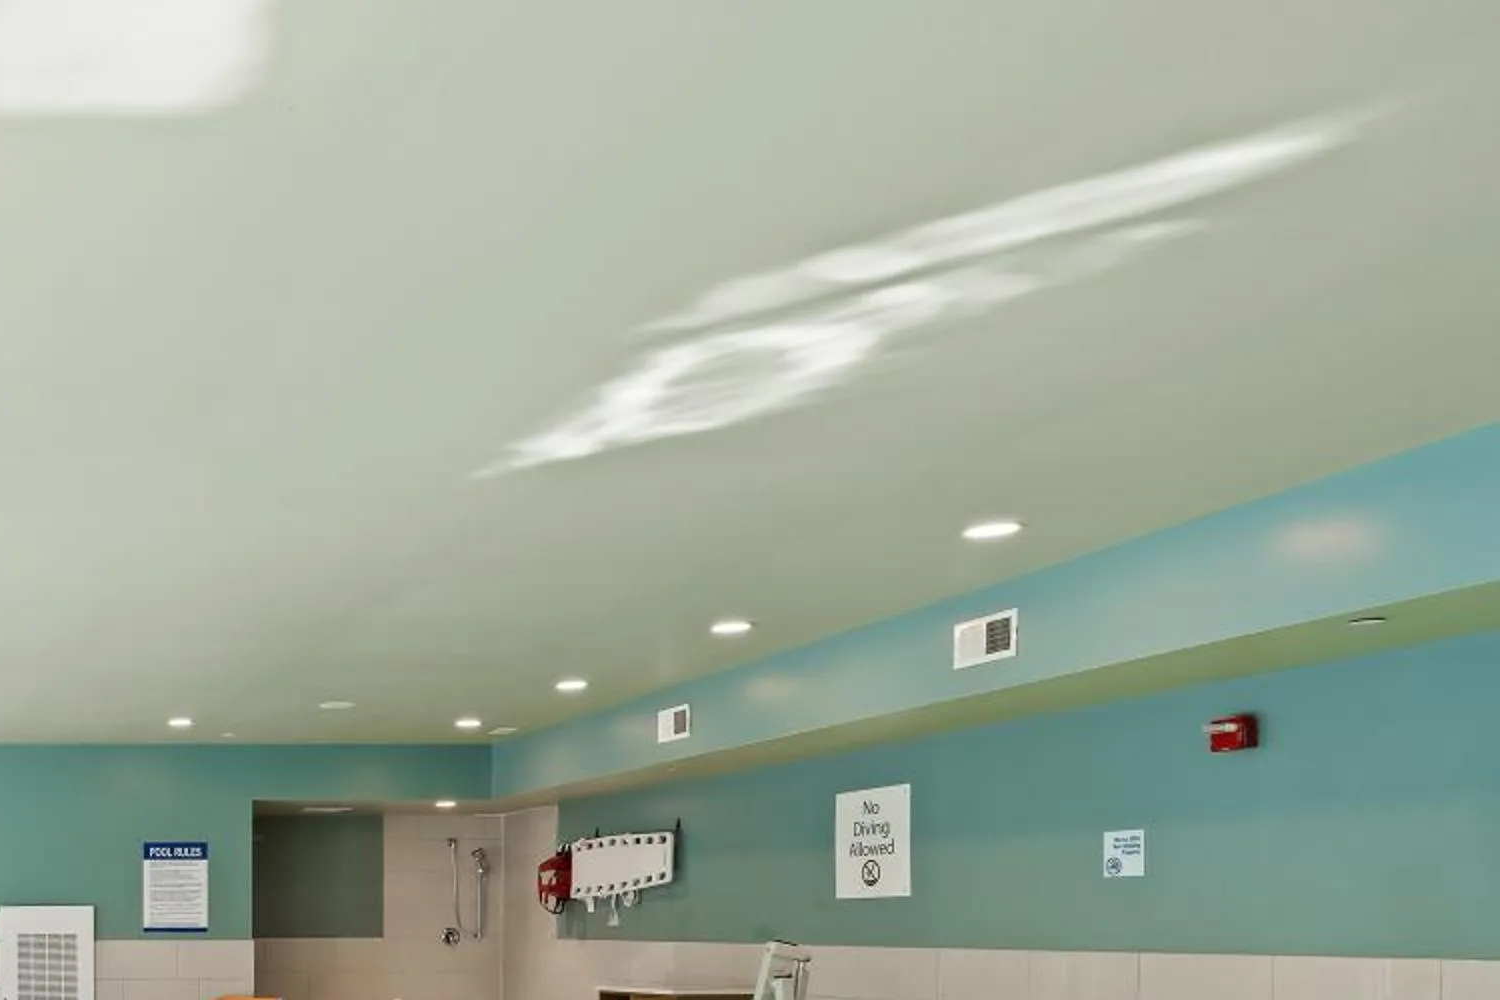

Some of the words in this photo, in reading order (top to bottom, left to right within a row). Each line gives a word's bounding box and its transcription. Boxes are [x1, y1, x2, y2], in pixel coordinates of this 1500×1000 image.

[863, 800, 880, 815] No
[853, 821, 890, 838] Diving
[149, 847, 172, 857] POOL
[173, 847, 203, 857] RULES
[850, 839, 895, 857] Allowed
